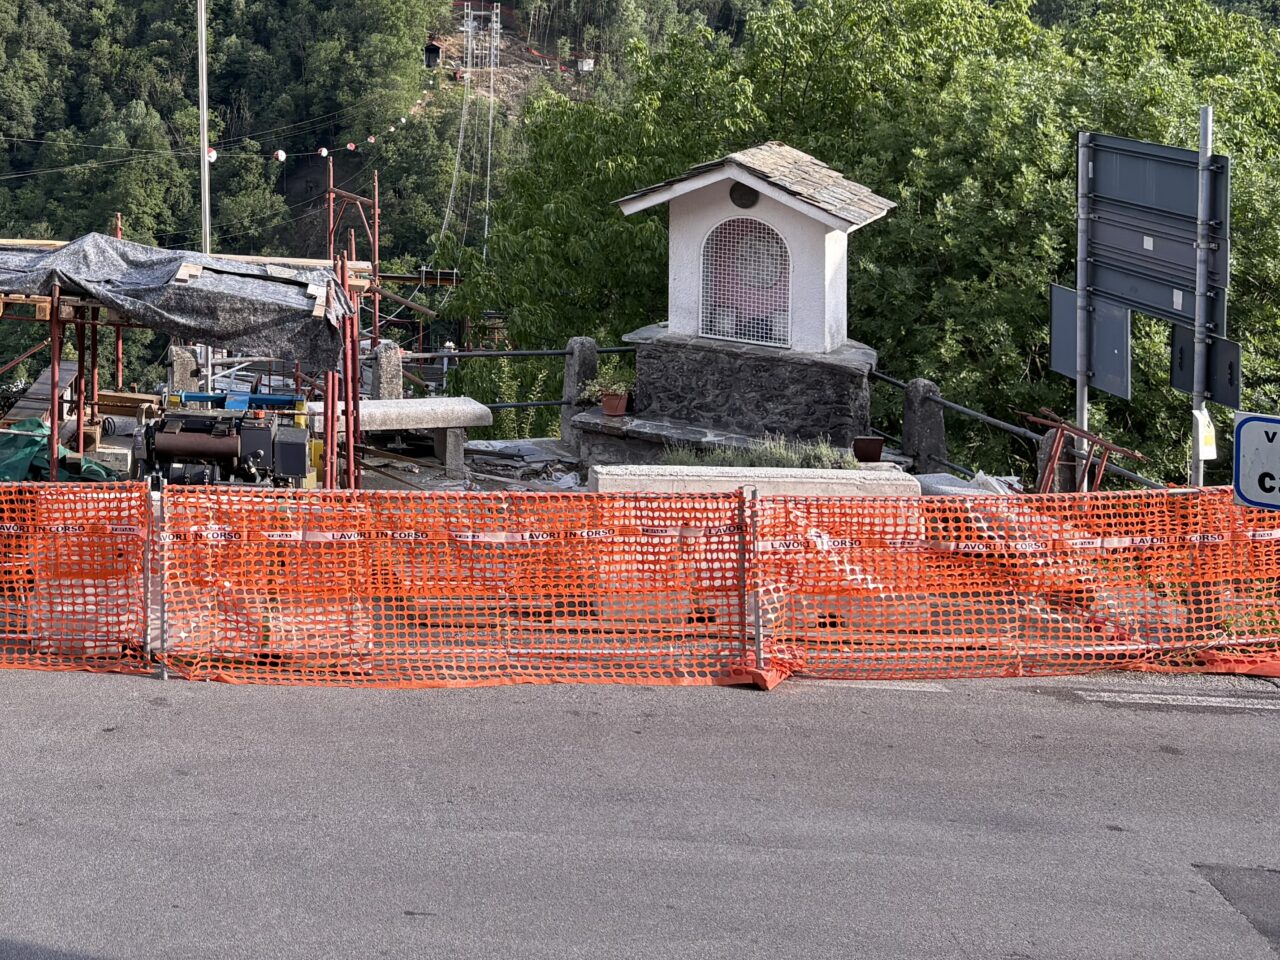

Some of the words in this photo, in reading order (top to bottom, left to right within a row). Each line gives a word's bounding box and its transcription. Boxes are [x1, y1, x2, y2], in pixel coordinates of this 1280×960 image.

[1258, 472, 1280, 494] C
[33, 525, 46, 533] IN
[48, 525, 86, 533] CORSO
[708, 525, 748, 535] LAVORI
[161, 533, 187, 542] VORI
[191, 532, 203, 541] IN
[206, 531, 242, 540] CORSO
[331, 532, 371, 540] LAVORI
[375, 531, 388, 540] IN
[391, 531, 429, 539] CORSO
[520, 531, 560, 541] LAVORI
[564, 530, 577, 539] IN
[580, 528, 616, 537] CORSO
[1130, 536, 1171, 545] LAVORI
[1173, 535, 1186, 543] IN
[1188, 533, 1225, 542] CORSO
[770, 541, 810, 549] LAVORI
[827, 540, 862, 548] CORSO
[956, 543, 996, 551] LAVORI
[1014, 542, 1048, 550] CORSO
